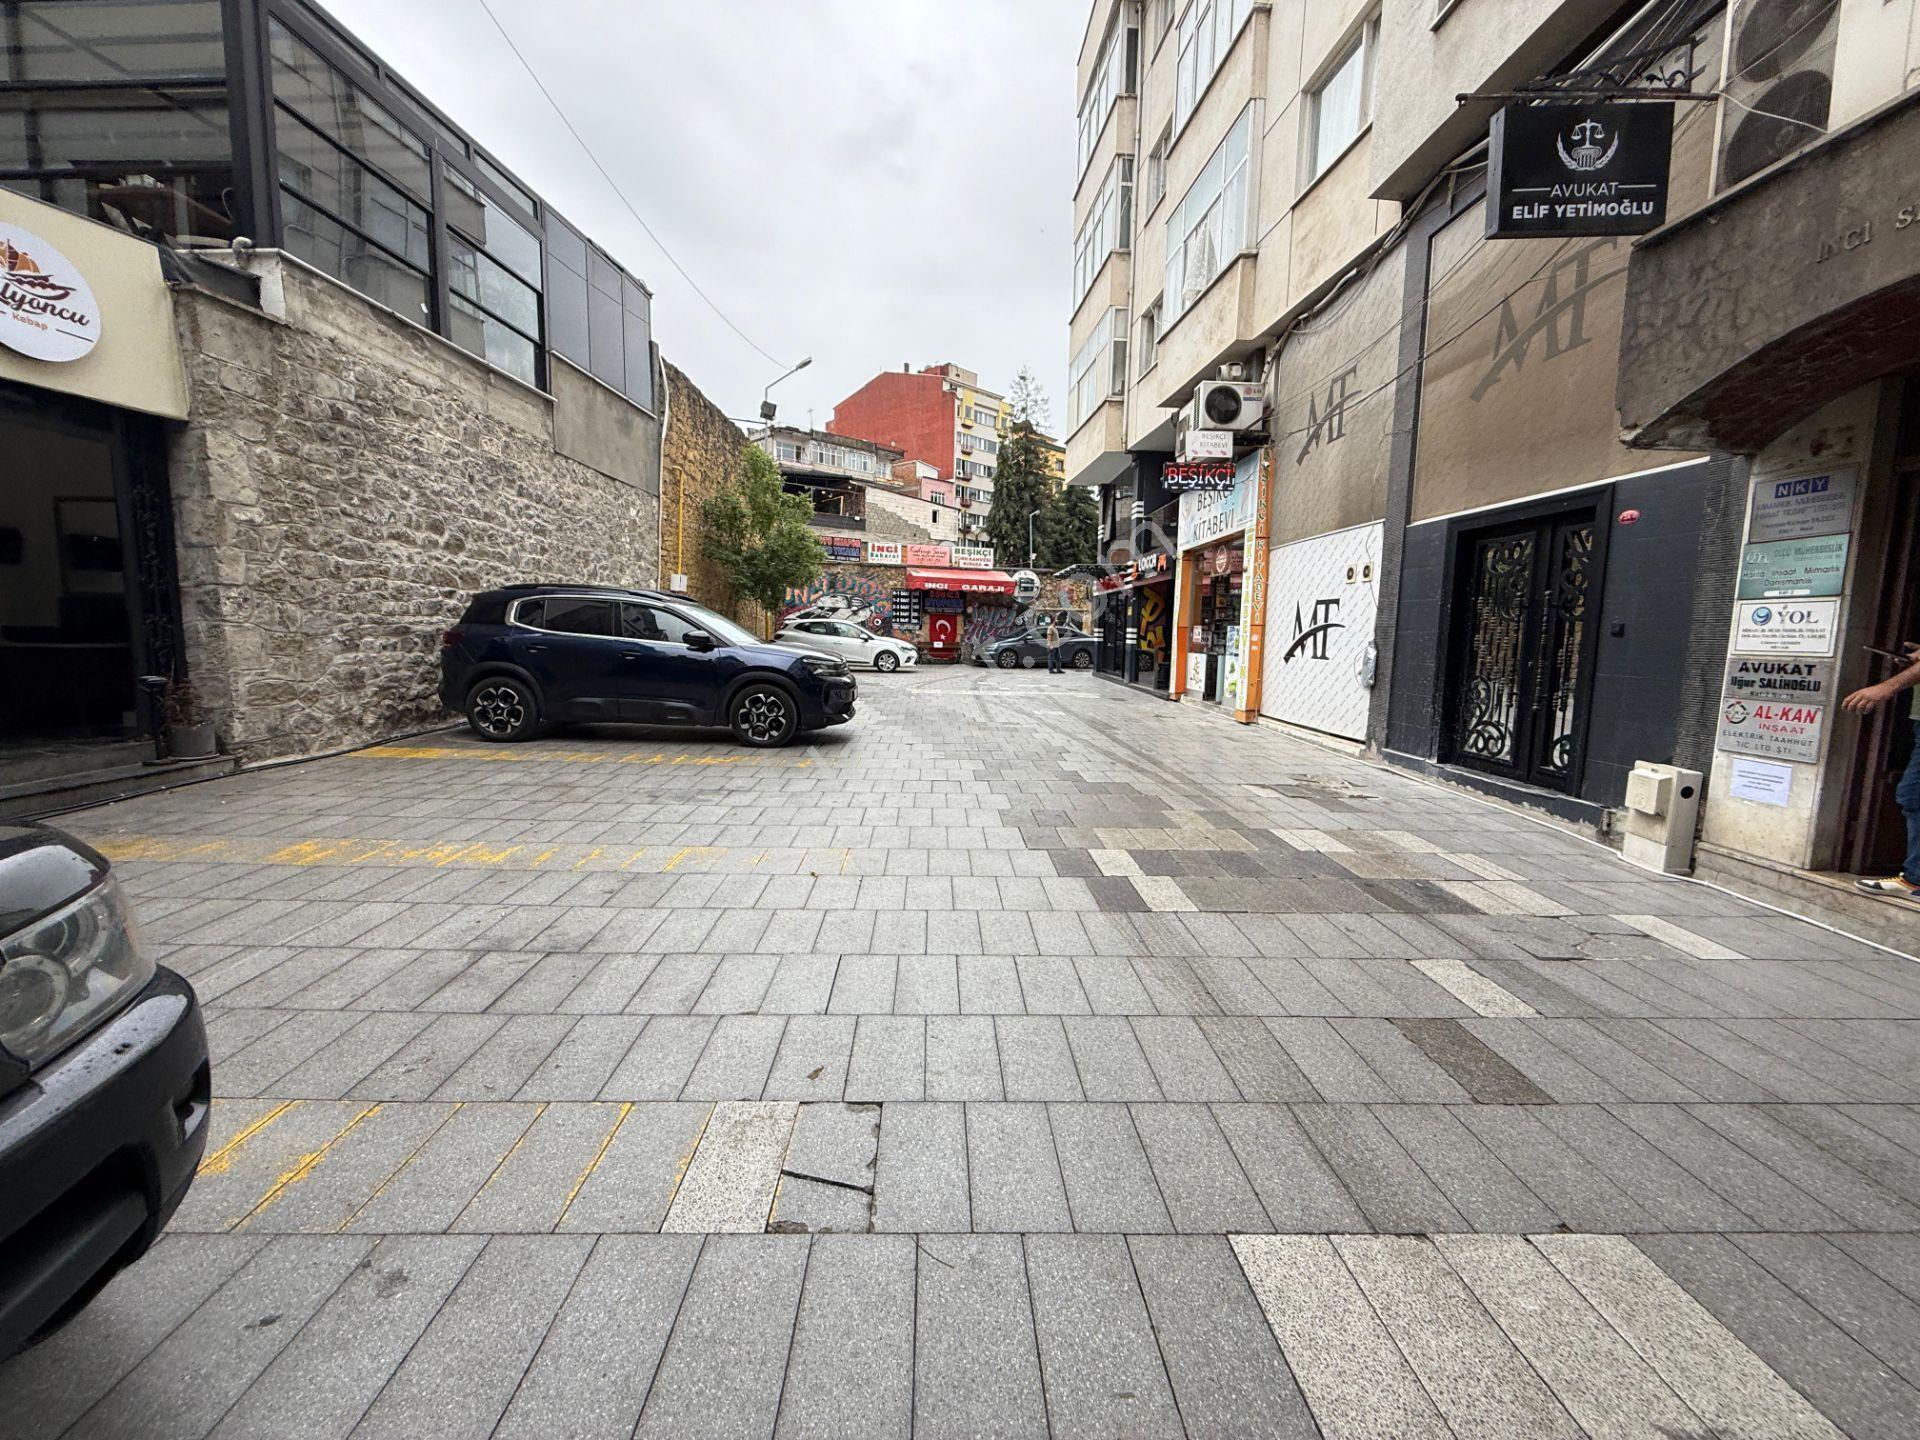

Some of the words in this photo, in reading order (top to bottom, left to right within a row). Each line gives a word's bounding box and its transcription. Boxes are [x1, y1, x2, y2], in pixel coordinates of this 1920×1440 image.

[1550, 181, 1619, 198] AVUKAT
[1512, 202, 1550, 219] ELİF
[1554, 199, 1654, 218] YETİMOĞLU
[1896, 204, 1920, 230] S
[12, 312, 48, 331] Kebap
[1167, 465, 1231, 488] BEŞİKÇİ
[1778, 478, 1828, 497] NKY
[1193, 501, 1235, 542] KİTABEVİ
[871, 543, 898, 553] İNCİ
[954, 548, 992, 557] BEŞİKÇİ
[961, 584, 1005, 592] GARAJI
[1777, 608, 1819, 624] YOL
[1738, 661, 1817, 676] AVUKAT
[1730, 676, 1757, 689] Uğur
[1758, 676, 1822, 692] SALİHOĞLU
[1753, 705, 1821, 724] AL-KAN
